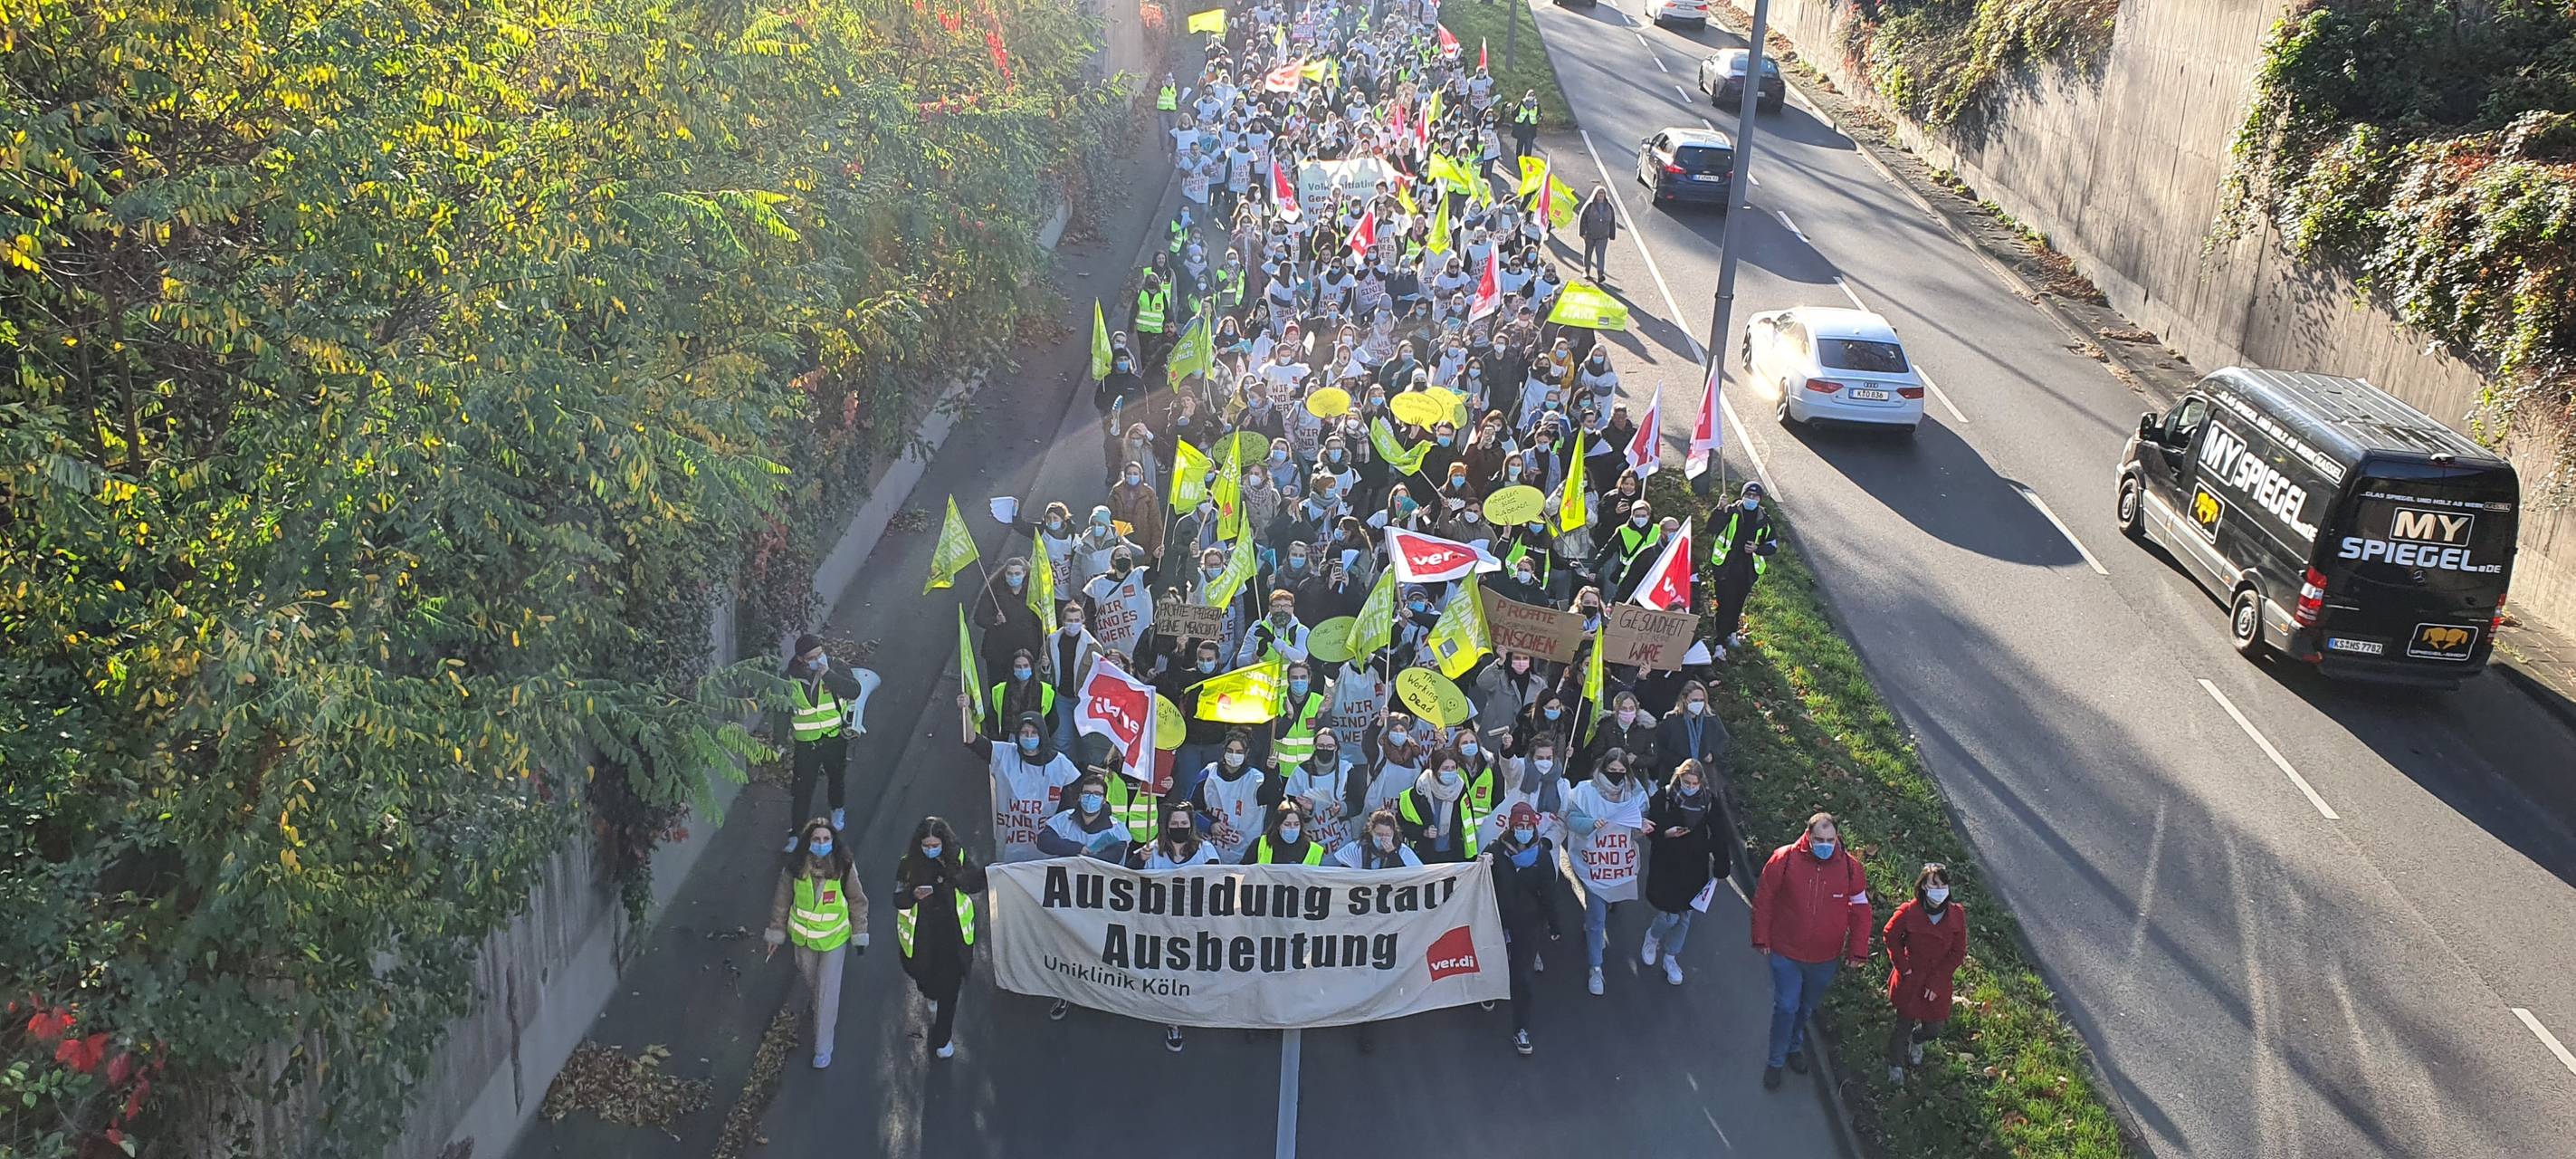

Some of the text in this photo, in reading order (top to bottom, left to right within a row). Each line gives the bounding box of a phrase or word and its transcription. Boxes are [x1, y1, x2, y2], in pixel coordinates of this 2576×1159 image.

[2201, 426, 2243, 477] MY
[2393, 510, 2470, 543] MY
[1099, 599, 1123, 616] WIR
[1098, 609, 1138, 631] IND ES
[1619, 609, 1688, 637] GESUNDHEIT
[1423, 672, 1437, 685] The
[1407, 673, 1439, 704] Working
[1343, 700, 1373, 714] WIR
[1408, 692, 1436, 714] Dead
[1331, 715, 1367, 728] SIND
[1008, 798, 1041, 815] WIR
[997, 812, 1032, 829] SIND
[1006, 830, 1036, 845] WER
[1595, 833, 1627, 848] WIR
[1580, 849, 1619, 866] SIND
[1589, 865, 1637, 881] WERT.
[1042, 866, 1331, 921] Ausbildung
[1102, 924, 1398, 973] Ausbeutung
[1430, 953, 1475, 972] ver.di
[1044, 953, 1191, 998] Uniklinik Köln
